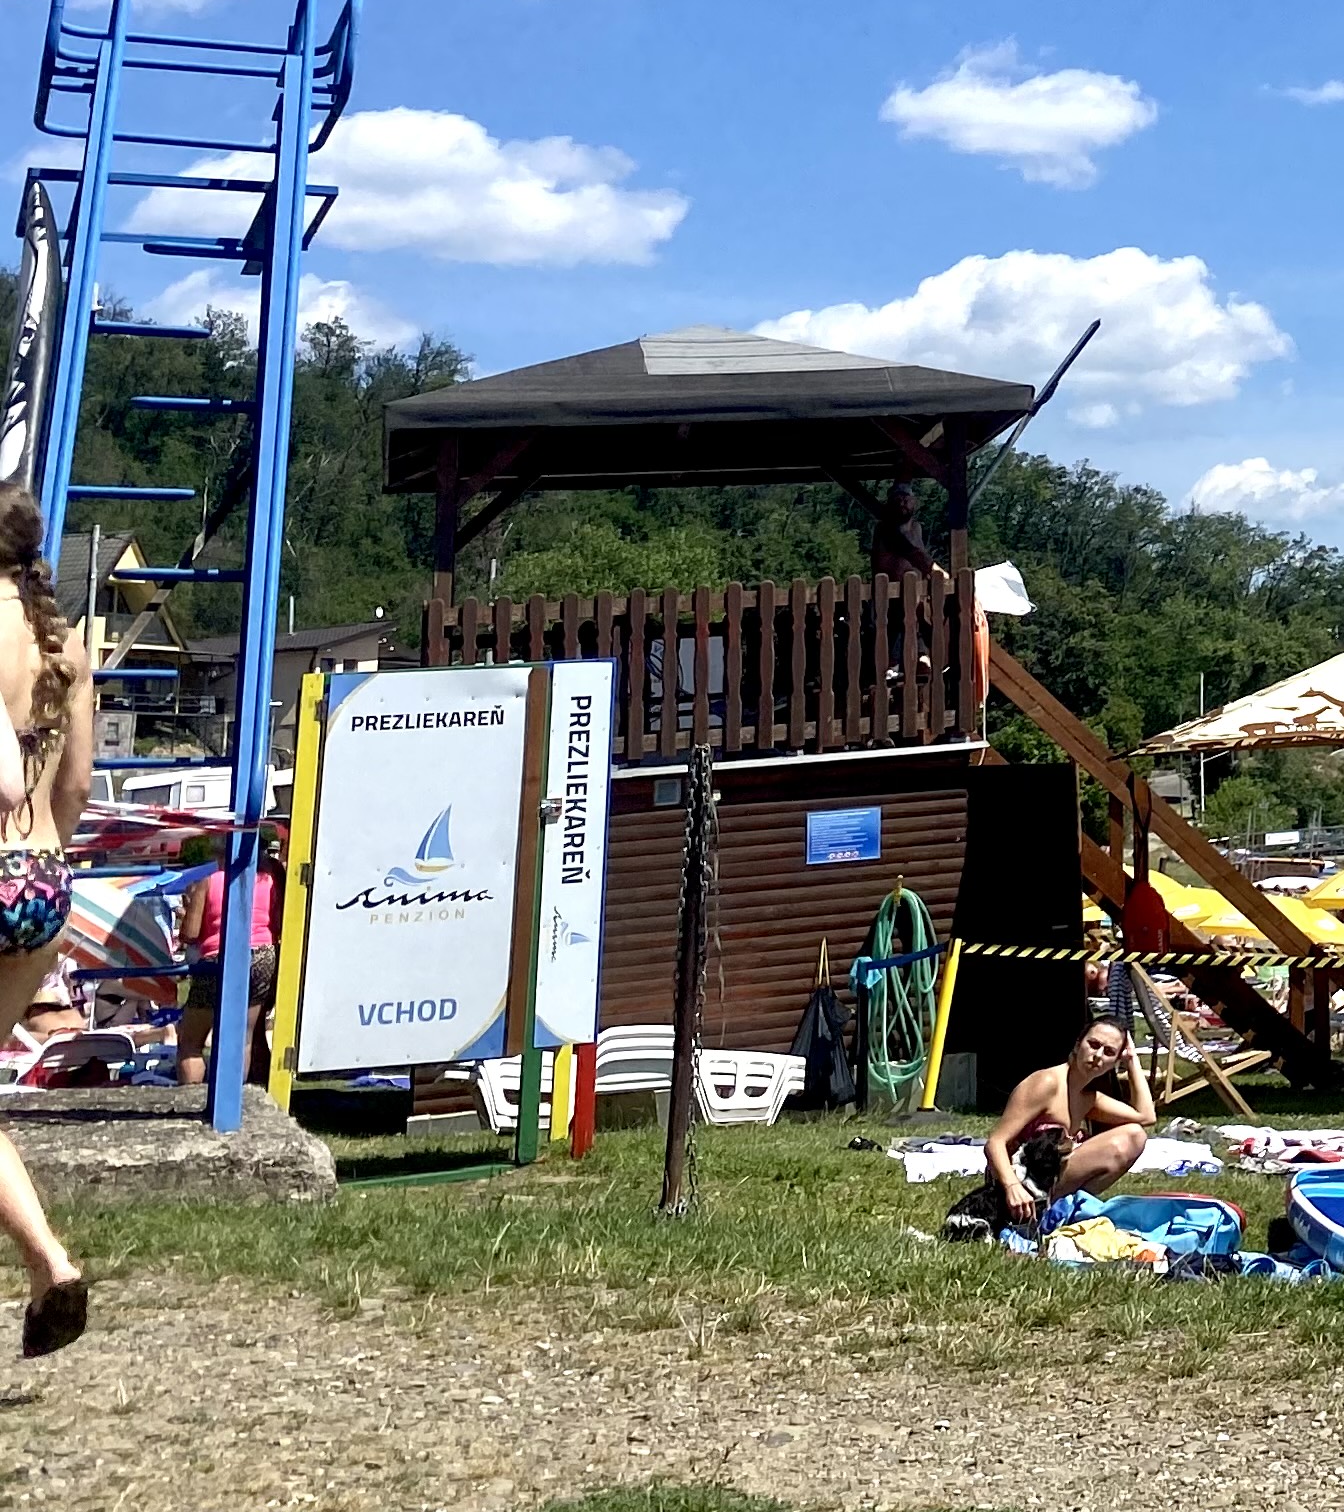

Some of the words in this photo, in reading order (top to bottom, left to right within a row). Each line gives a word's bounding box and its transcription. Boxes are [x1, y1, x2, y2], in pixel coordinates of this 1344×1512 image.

[351, 704, 505, 732] PREZLIEKAREŇ
[561, 695, 592, 885] PREZLIEKAREŇ
[358, 997, 458, 1026] VCHOD
